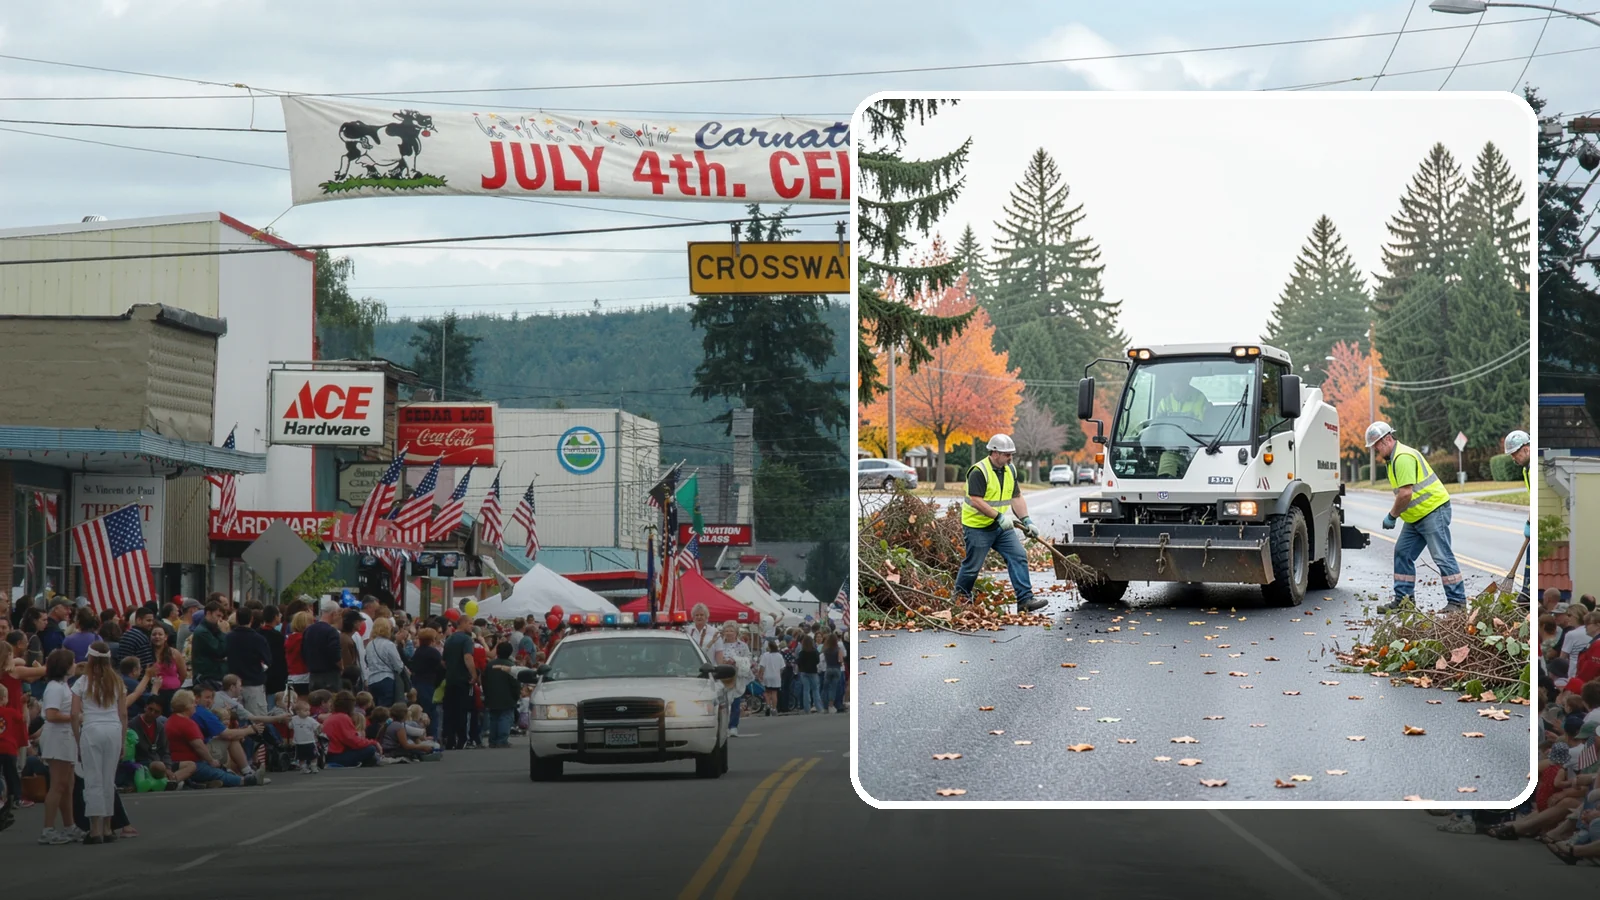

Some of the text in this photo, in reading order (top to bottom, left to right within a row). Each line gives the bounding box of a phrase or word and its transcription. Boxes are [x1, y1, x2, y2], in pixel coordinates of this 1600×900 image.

[695, 121, 850, 150] Carnat
[481, 140, 605, 192] JULY
[632, 150, 746, 198] 4th.
[697, 254, 850, 280] CROSSWA
[282, 380, 374, 420] ACE
[406, 409, 485, 422] CEDAR LOG
[283, 421, 371, 436] Hardware
[416, 428, 477, 447] Coca-Cola
[353, 467, 385, 479] Simpl
[95, 485, 124, 495] Vincent
[126, 486, 136, 495] de
[137, 486, 155, 495] Paul
[688, 526, 741, 535] CRNATION
[699, 535, 730, 543] GLASS
